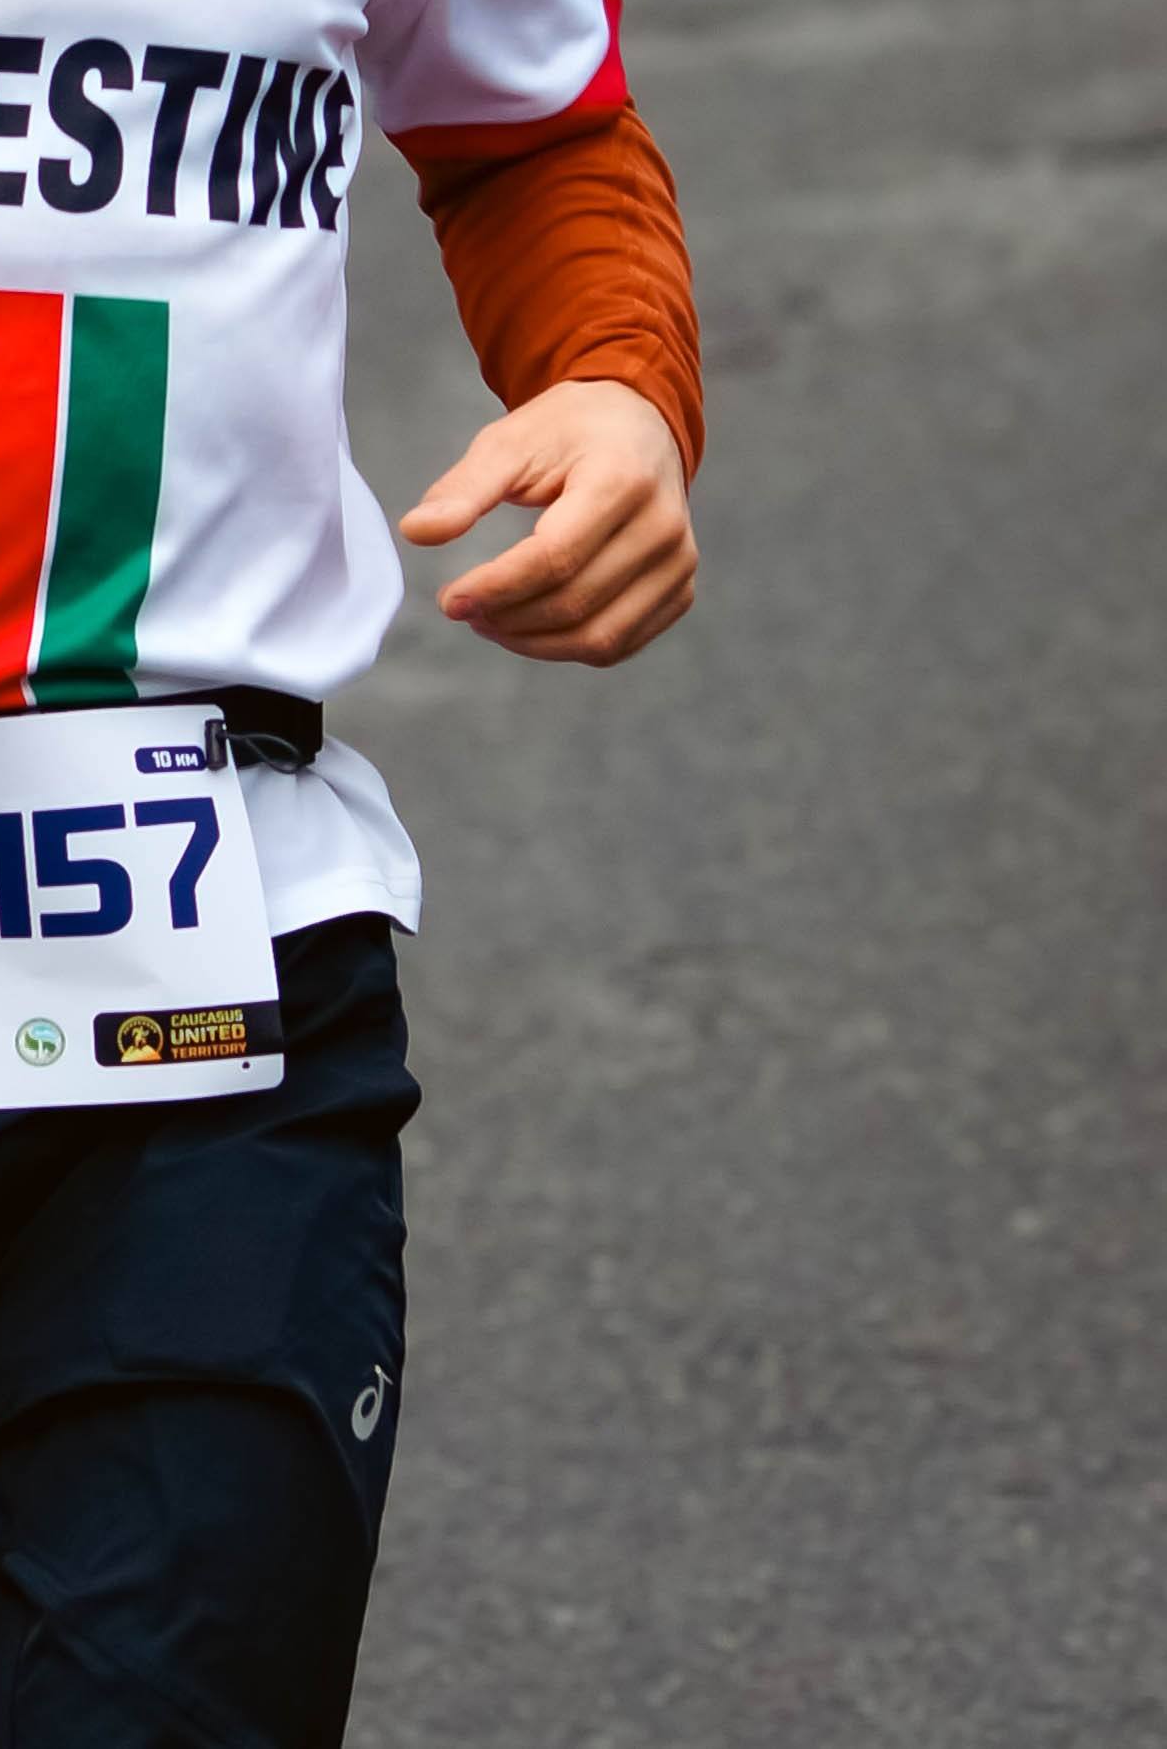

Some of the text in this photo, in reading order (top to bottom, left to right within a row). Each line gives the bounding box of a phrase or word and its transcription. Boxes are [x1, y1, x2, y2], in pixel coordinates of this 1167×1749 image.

[151, 750, 172, 769] 10
[171, 1009, 243, 1027] CAUCASUS
[170, 1023, 246, 1045] UNITED
[171, 1042, 247, 1059] TERRITORY
